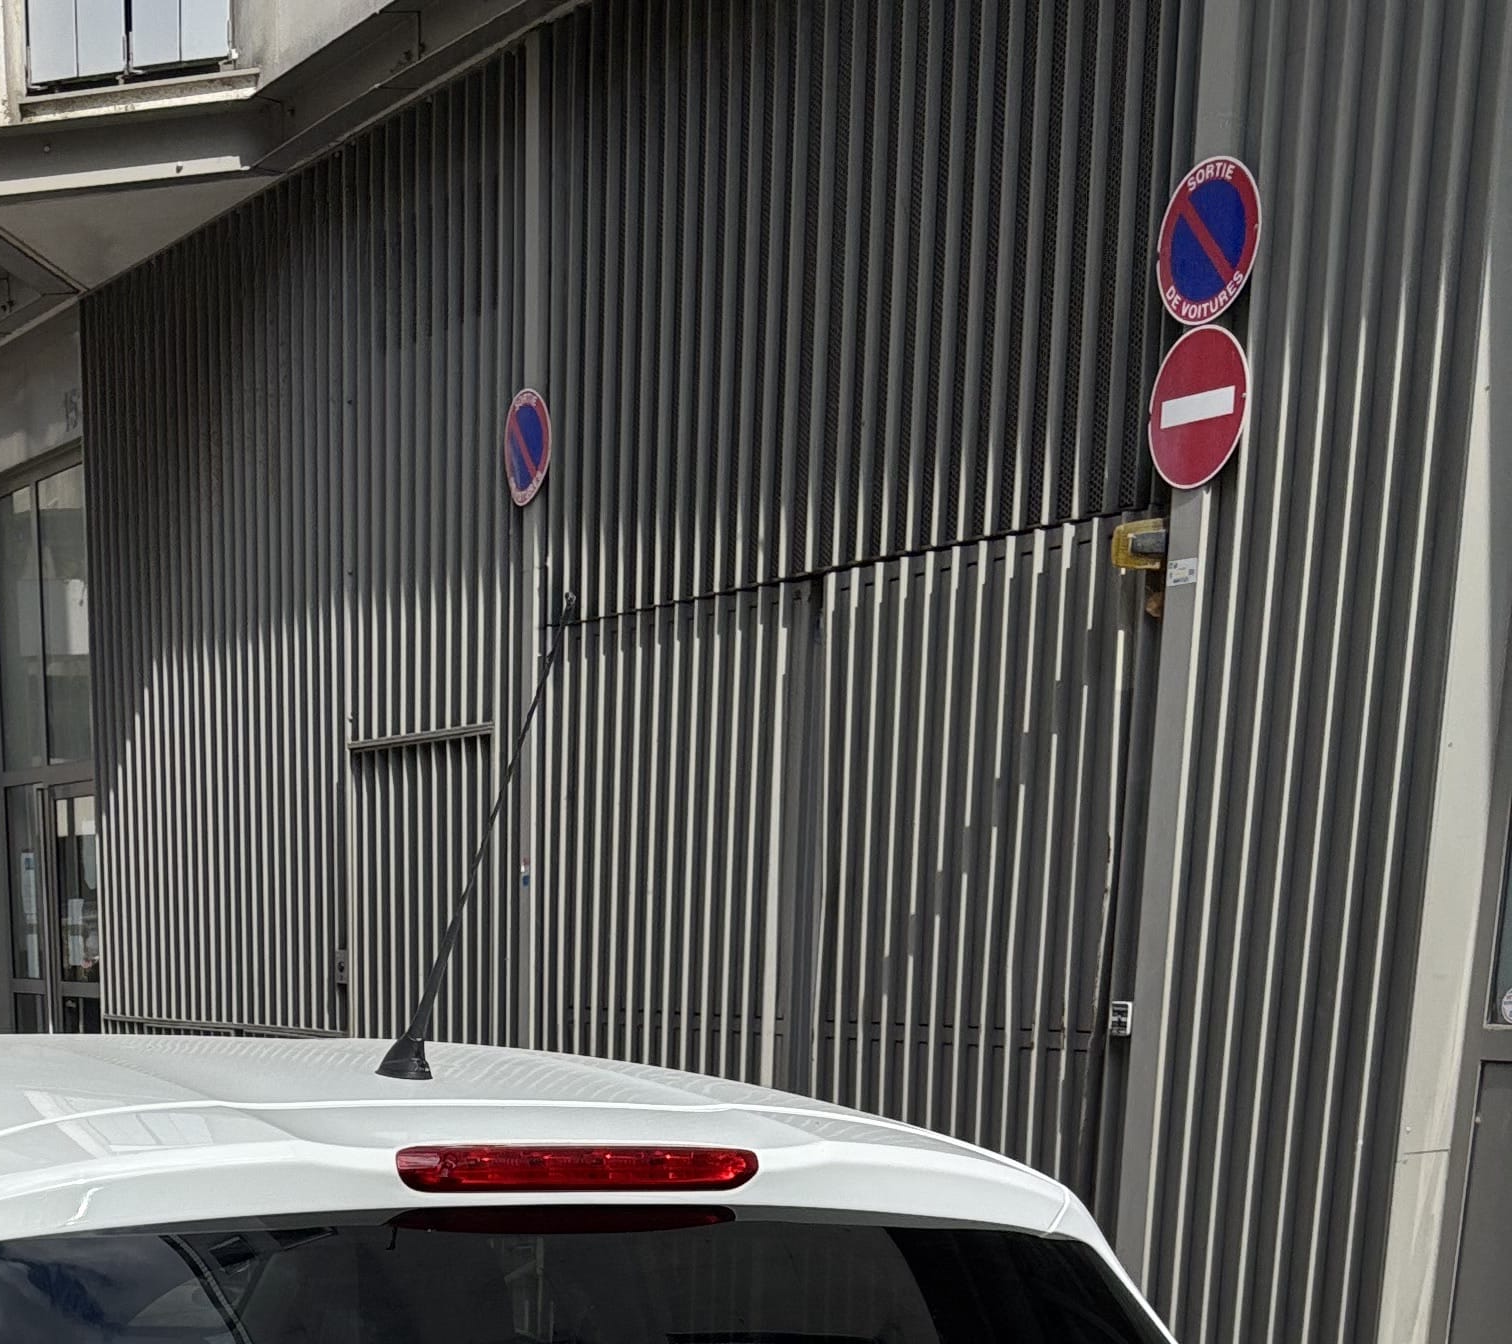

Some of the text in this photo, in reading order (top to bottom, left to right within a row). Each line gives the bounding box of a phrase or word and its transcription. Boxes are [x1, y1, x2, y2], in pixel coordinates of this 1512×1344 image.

[1186, 161, 1236, 192] SORTIE
[1165, 270, 1244, 320] DE VOITURES
